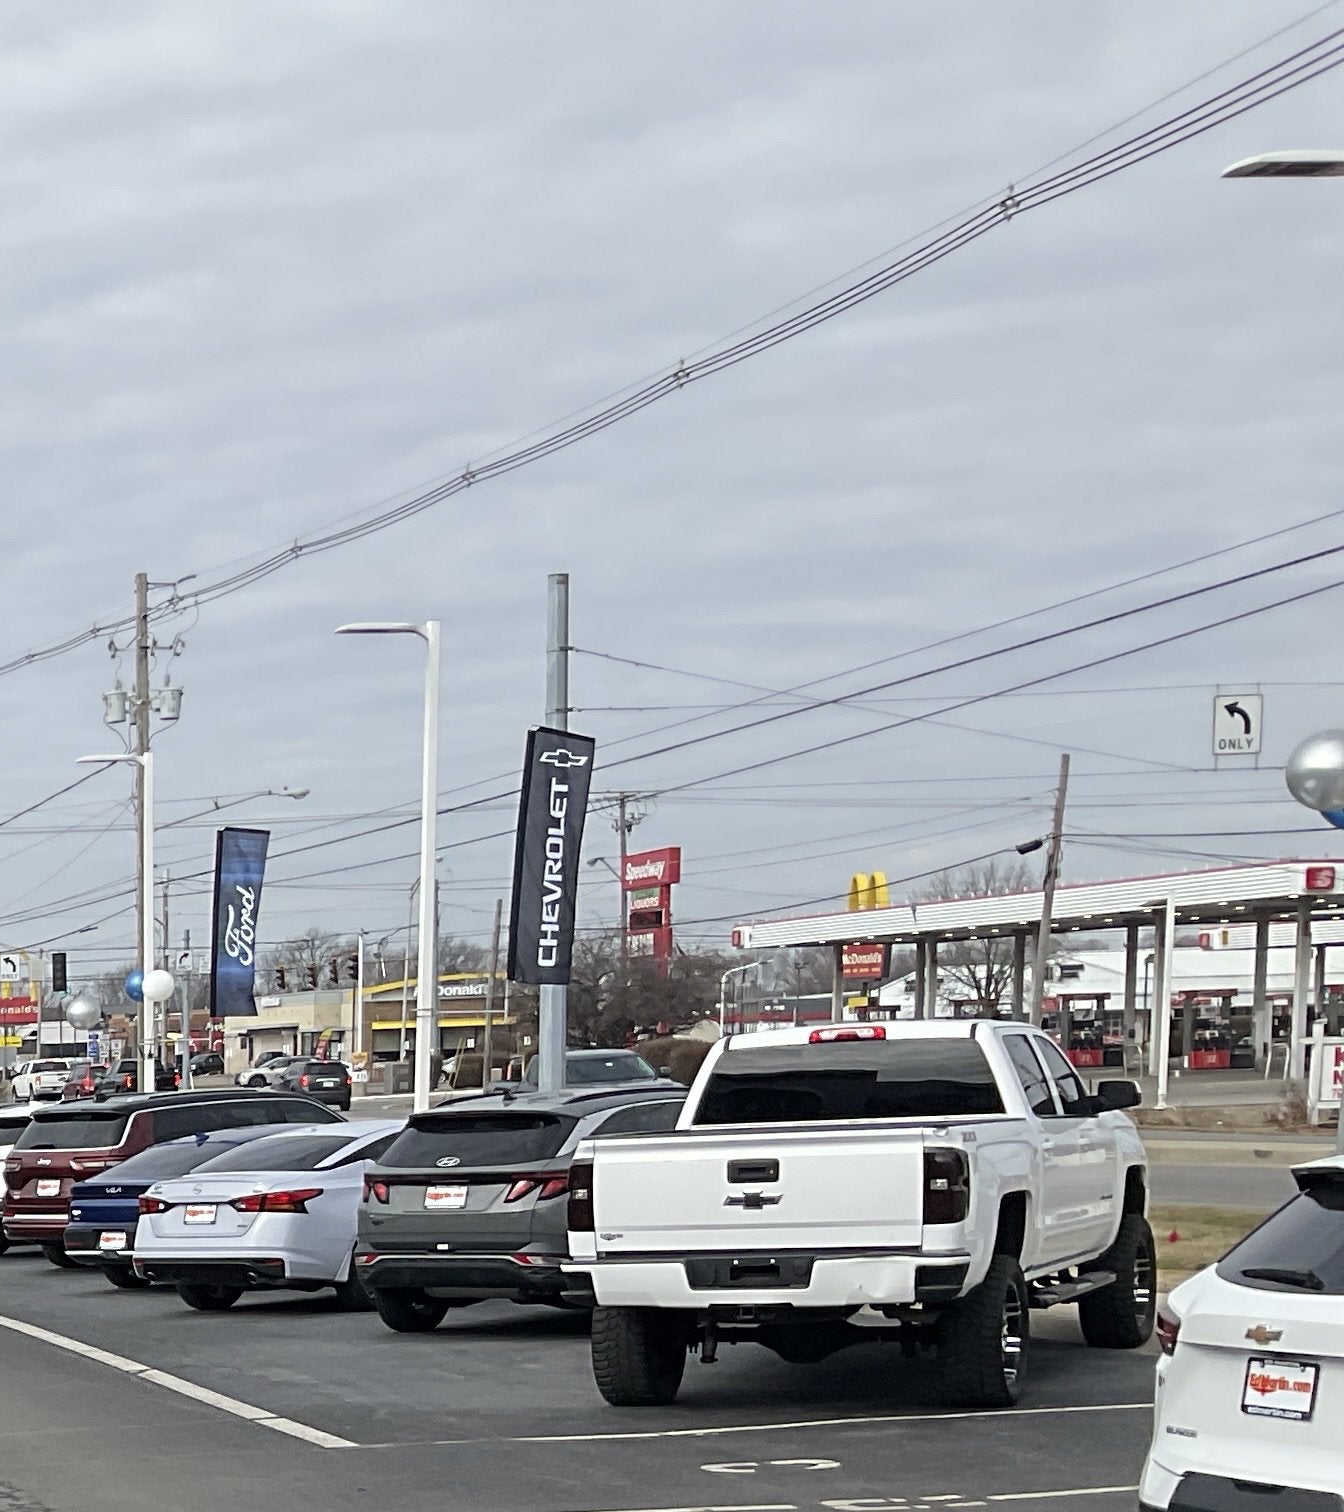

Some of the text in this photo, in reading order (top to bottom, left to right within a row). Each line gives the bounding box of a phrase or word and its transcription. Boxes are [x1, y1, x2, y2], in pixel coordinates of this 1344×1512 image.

[1218, 738, 1254, 750] ONLY
[537, 777, 569, 967] CHEVROLET
[626, 859, 666, 885] Speedway
[224, 885, 255, 967] Ford
